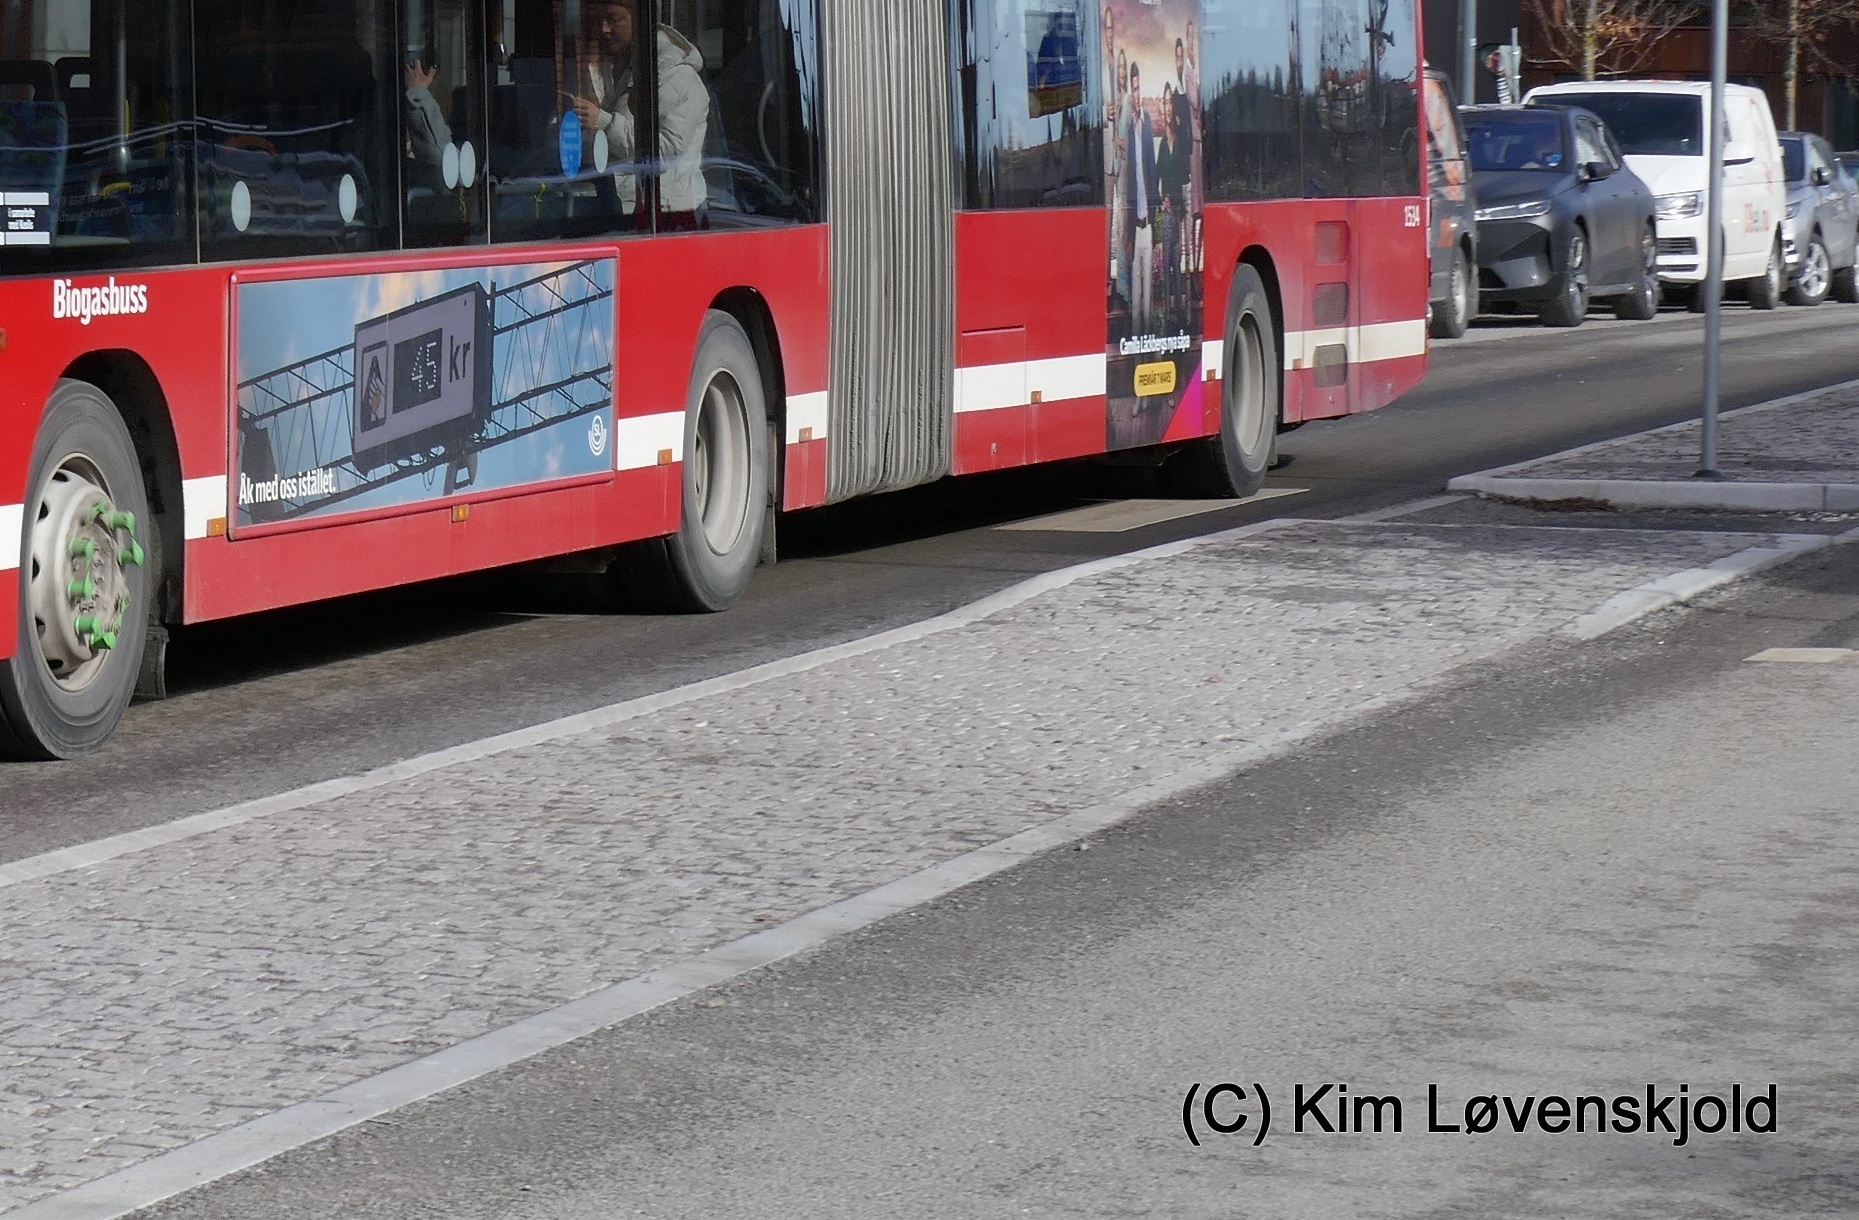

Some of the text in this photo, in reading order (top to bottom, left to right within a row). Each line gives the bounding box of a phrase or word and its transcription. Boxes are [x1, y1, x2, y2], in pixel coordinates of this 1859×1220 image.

[1404, 205, 1420, 227] 1534
[53, 277, 148, 326] Biogasbuss
[411, 335, 471, 393] 45 kr
[239, 467, 336, 505] Åk med oss istället.
